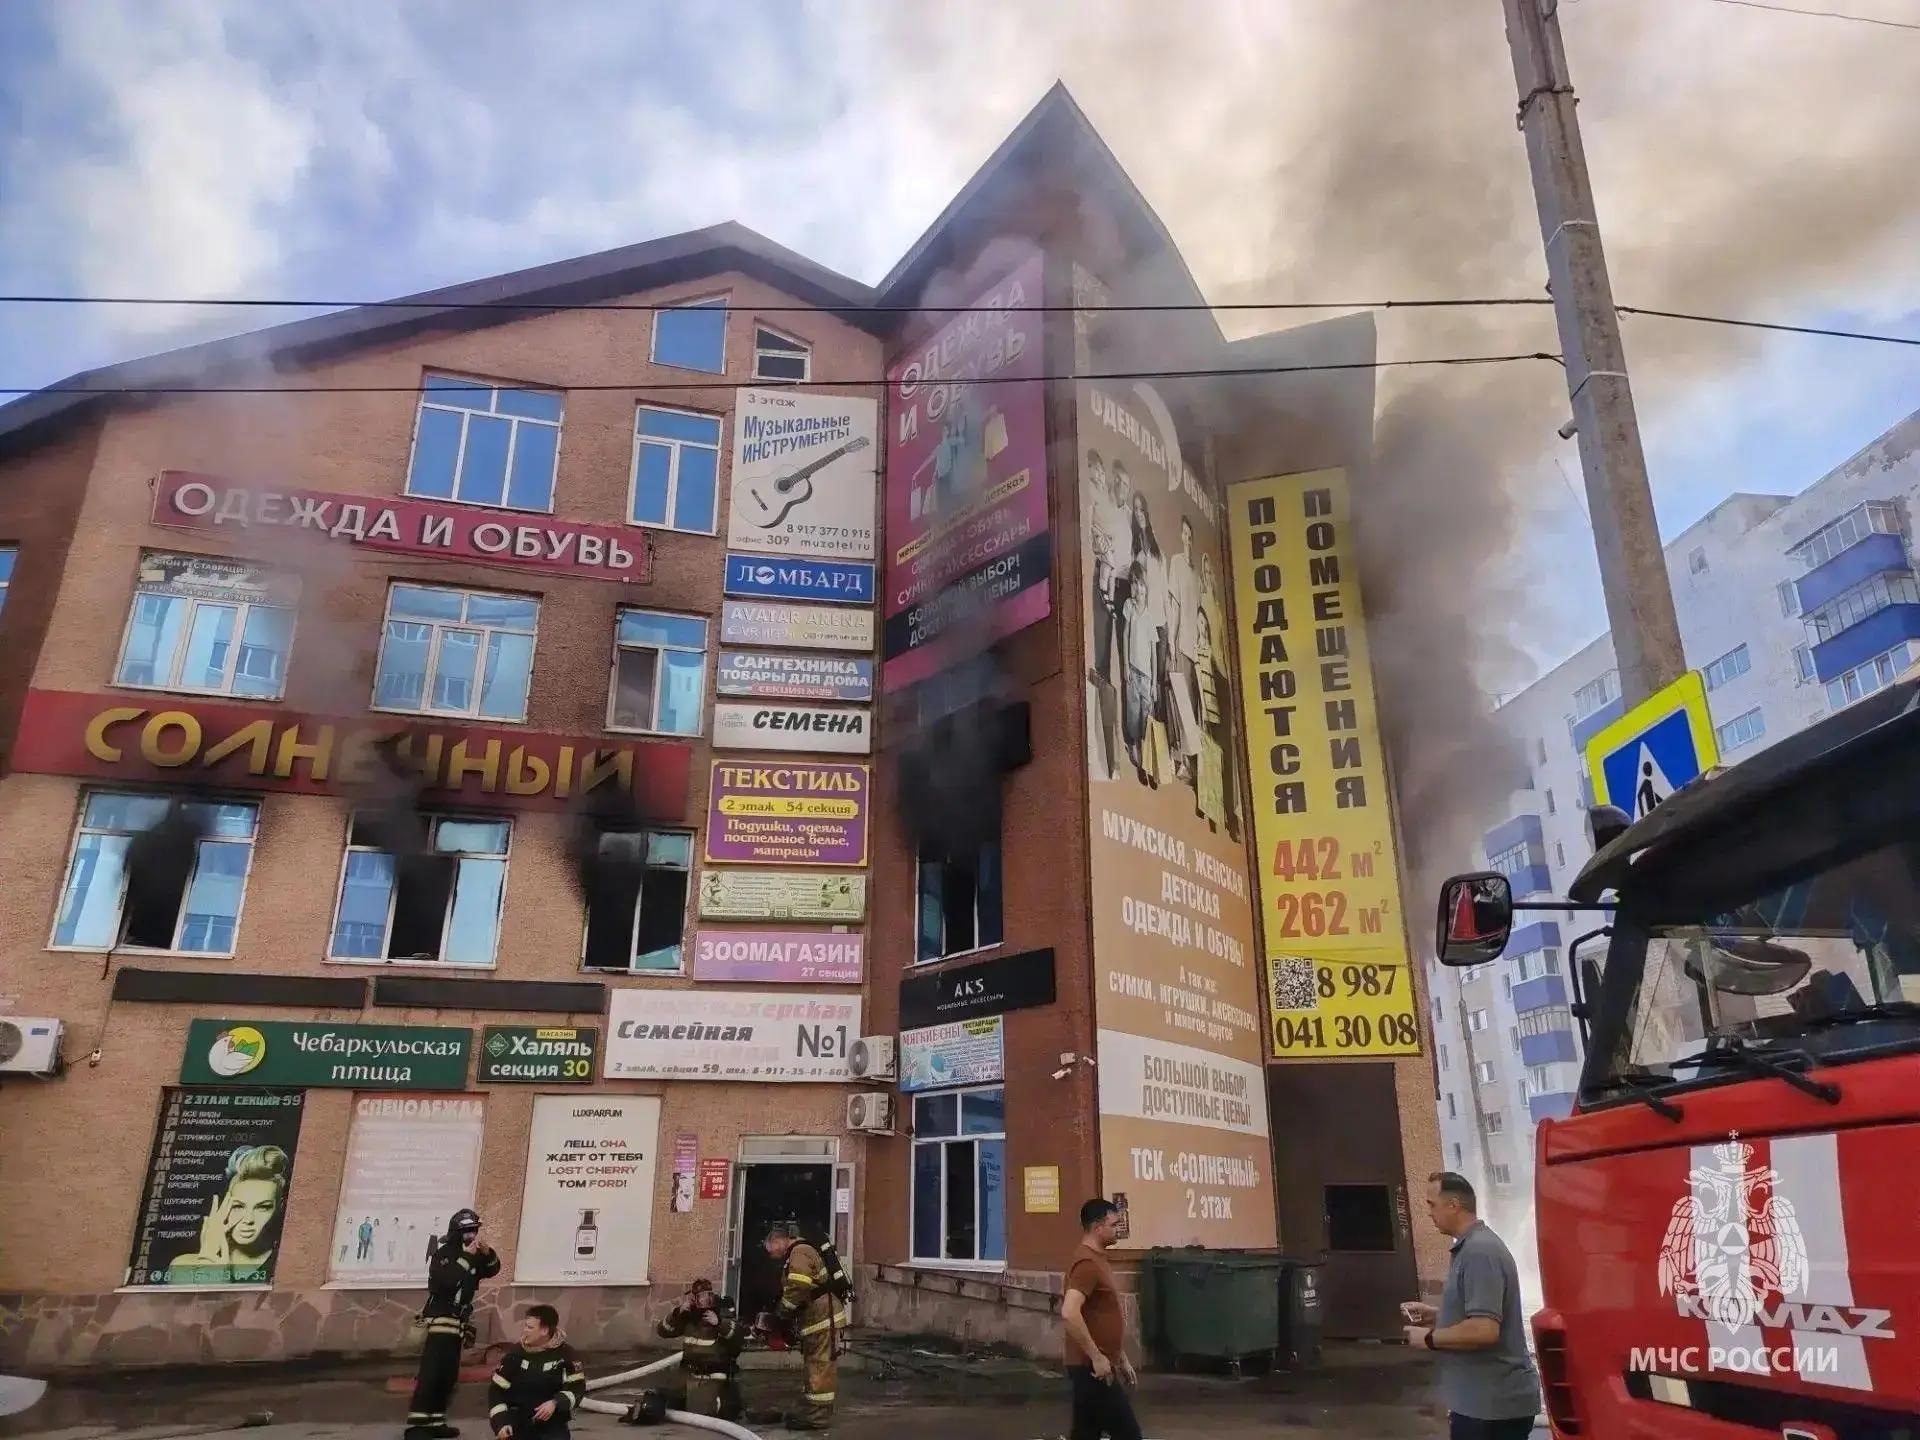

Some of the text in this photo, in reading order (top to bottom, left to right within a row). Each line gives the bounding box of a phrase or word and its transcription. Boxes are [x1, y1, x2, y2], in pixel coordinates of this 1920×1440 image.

[748, 393, 796, 408] 3 этаж
[743, 415, 851, 440] Музыкальные
[900, 404, 919, 447] И
[742, 427, 850, 465] ИНСТРУМЕНТЫ
[173, 481, 635, 570] ОДЕЖДА И ОБУВЬ
[786, 524, 871, 539] 8 917 377 0 915
[735, 536, 763, 546] офис
[766, 535, 790, 545] 309
[736, 564, 863, 593] ЛОМБАРД
[1248, 496, 1307, 814] ПРОДАЮТСЯ
[1303, 487, 1367, 809] ПОМЕЩЕНИЯ
[733, 655, 859, 675] САНТЕХНИКА
[720, 669, 869, 688] ТОВАРЫ ДЛЯ ДОМА
[758, 686, 806, 696] СЕКЦИЯ
[752, 710, 863, 734] СЕМЕНА
[85, 706, 637, 799] СОЛНЕЧНЫЙ
[719, 767, 861, 793] ТЕКСТИЛЬ
[726, 799, 851, 816] 2 этаж 54 секция
[728, 819, 848, 836] Подушки, одеяла,
[724, 833, 850, 847] постельное белье,
[753, 847, 820, 858] матрацы
[1102, 809, 1249, 905] МУЖСКАЯ, ЖЕНСКАЯ,
[1273, 837, 1342, 882] 442
[1161, 870, 1221, 920] ДЕТСКАЯ
[1122, 895, 1191, 948] ОДЕЖДА
[1195, 922, 1204, 950] И
[1277, 891, 1350, 938] 262
[699, 941, 860, 964] ЗООМАГАЗИН
[801, 967, 859, 980] 27 секция
[1188, 970, 1203, 989] так
[1316, 965, 1398, 998] 8 987
[1109, 970, 1157, 1004] СУМКИ,
[1160, 983, 1210, 1019] ИГРУШКИ,
[617, 1019, 754, 1041] Семейная
[796, 1022, 848, 1058] №1
[939, 1022, 960, 1040] СНЫ
[1275, 1013, 1418, 1049] 041 30 08
[292, 1031, 462, 1058] Чебаркульская
[510, 1036, 592, 1057] Халяль
[330, 1062, 412, 1084] птица
[490, 1060, 590, 1079] секция 30
[614, 1063, 622, 1073] 2
[1143, 1054, 1248, 1099] БОЛЬШОЙ ВЫБОР!
[184, 1095, 193, 1105] 2
[193, 1095, 229, 1105] ЭТАЖ
[282, 1095, 302, 1106] 59
[1143, 1084, 1252, 1127] ДОСТУПНЫЕ ЦЕНЫ!
[572, 1108, 623, 1118] LUXPARFUM
[563, 1138, 627, 1150] ЛЕШ, ОНА
[546, 1151, 644, 1163] ЖДЕТ ОТ ТЕБЯ
[1130, 1147, 1260, 1188] ТСК «СОЛНЕЧНЫЙ»
[548, 1165, 637, 1176] LOST CHERRY
[558, 1178, 628, 1190] TOM FORD!
[1186, 1188, 1233, 1220] 2 этаж
